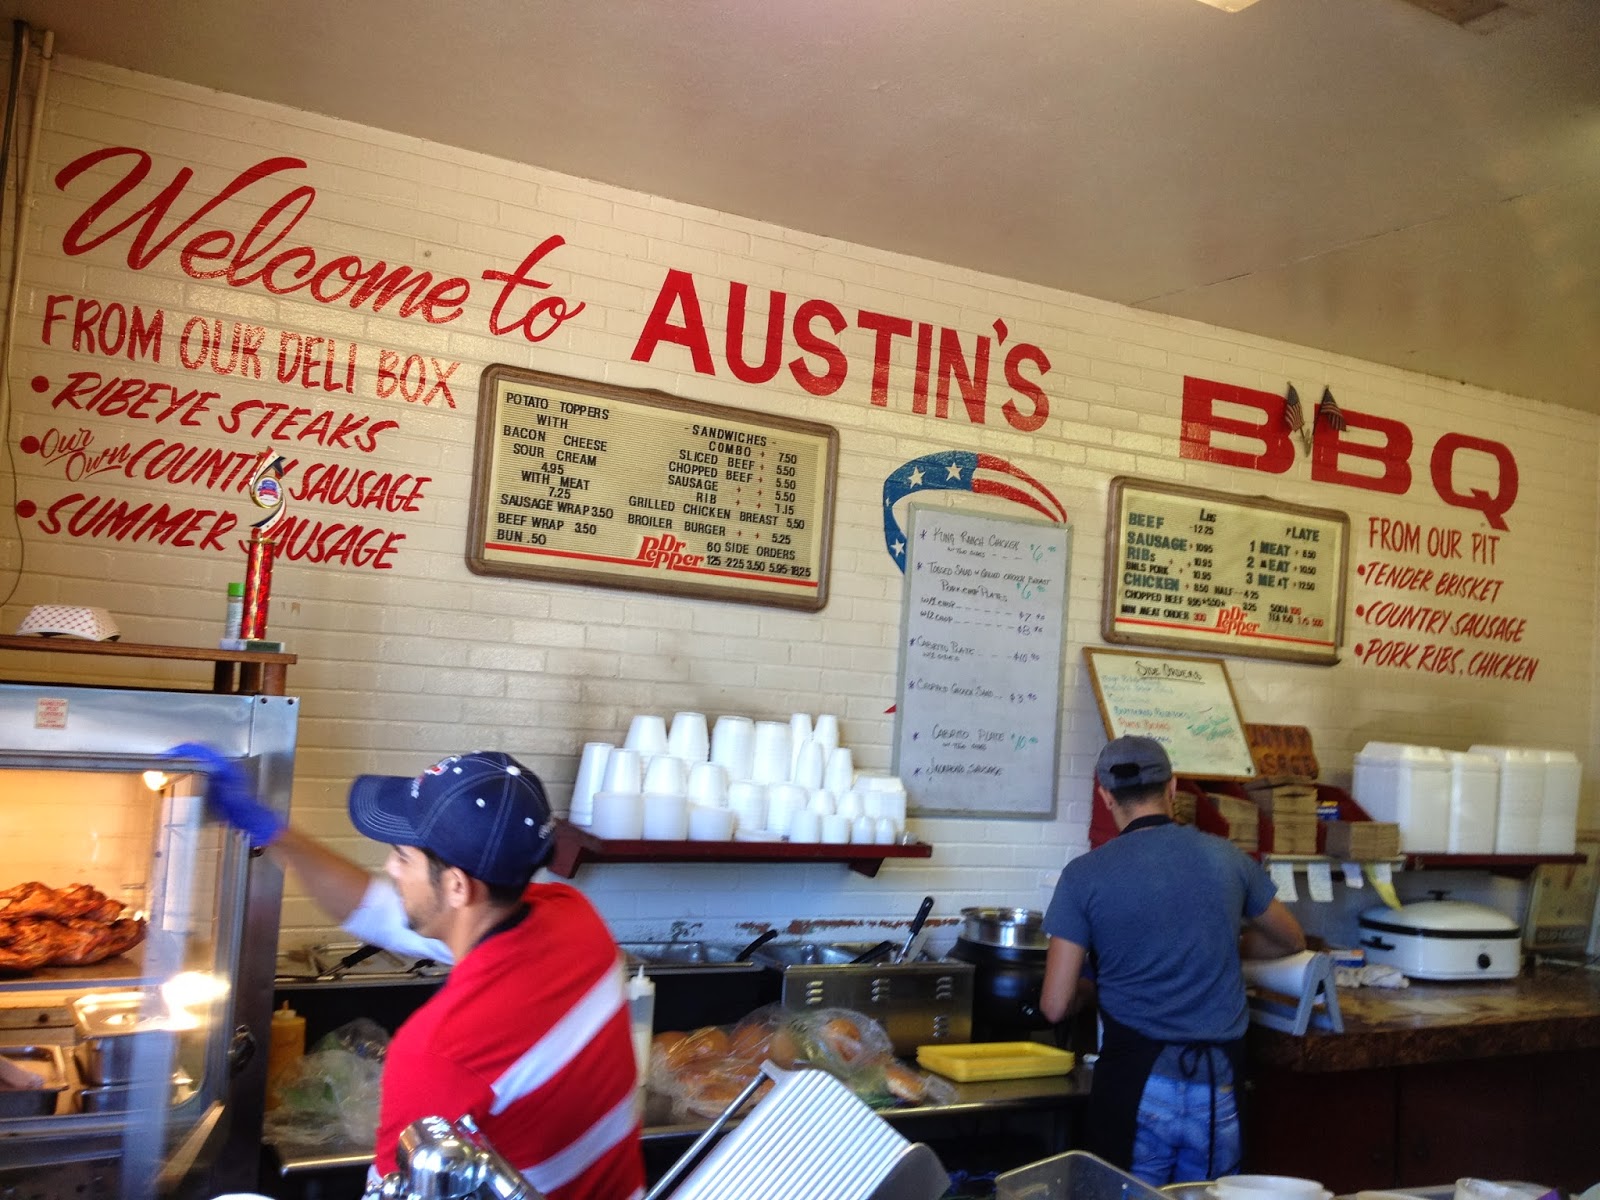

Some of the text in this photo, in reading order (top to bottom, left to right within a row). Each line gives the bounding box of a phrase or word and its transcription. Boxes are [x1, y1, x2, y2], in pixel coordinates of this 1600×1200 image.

[55, 146, 585, 342] Welcome to
[41, 295, 460, 409] FROM OUR DELI BOX
[631, 268, 1051, 432] AUSTIN'S
[52, 372, 399, 453] RIBEYE STEAKS
[506, 392, 610, 420] POTATO TOPPERS
[537, 414, 568, 429] WITH
[40, 428, 95, 463] Our
[503, 424, 608, 452] BACON CHEESE
[692, 425, 767, 447] SANDWICHES
[513, 443, 597, 466] SOUR CREAM
[679, 449, 718, 465] SLICED
[727, 457, 755, 470] BEEF
[709, 441, 751, 457] COMBO
[1179, 375, 1519, 532] BBQ
[541, 462, 564, 475] 4.95
[668, 461, 796, 490] CHOPPED BEEF 5.50
[289, 463, 432, 512] SAUSAGE
[521, 470, 590, 490] WITH MEAT
[668, 475, 796, 502] SAUSAGE 5.50
[549, 486, 571, 499] 7.25
[696, 492, 717, 504] RIB
[500, 493, 554, 511] SAUSAGE
[557, 501, 590, 515] WRAP
[629, 496, 675, 512] GRILLED
[683, 503, 731, 519] CHICKEN
[740, 511, 779, 526] BREAST
[39, 492, 237, 551] SUMMER
[498, 512, 527, 526] BEEF
[532, 517, 564, 530] WRAP
[628, 513, 672, 529] BROILER
[684, 521, 726, 536] BURGER
[1129, 512, 1164, 529] BEEF
[497, 529, 547, 545] BUN .50
[662, 533, 686, 553] Dr
[1127, 531, 1188, 552] SAUSAGE
[1286, 526, 1320, 542] PLATE
[1369, 517, 1500, 565] FROM OUR PIT
[637, 536, 705, 570] Pepper
[725, 542, 749, 554] SIDE
[756, 546, 795, 560] ORDERS
[1250, 540, 1255, 552] 1
[1260, 541, 1291, 557] MEAT
[1247, 556, 1254, 568] 2
[1123, 572, 1180, 592] CHICKEN
[1246, 572, 1253, 584] 3
[1258, 573, 1290, 590] MEAT
[1365, 561, 1504, 603] TENDER BRISKET
[1125, 590, 1162, 602] CHOPPED
[1165, 594, 1184, 605] BEEF
[1216, 608, 1260, 635] Pepper
[1231, 606, 1248, 621] Dr
[1365, 600, 1527, 643] COUNTRY SAUSAGE
[1363, 638, 1419, 668] PORK
[1466, 650, 1539, 683] CHICKEN
